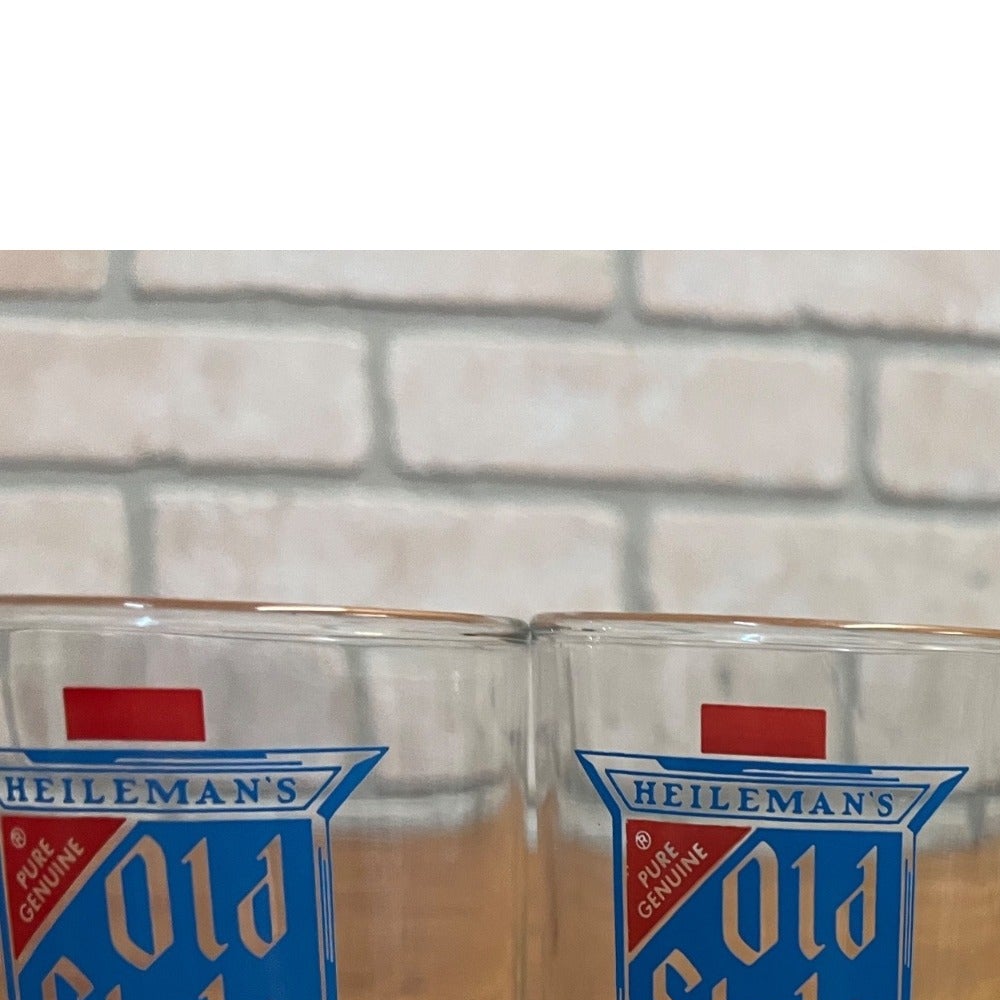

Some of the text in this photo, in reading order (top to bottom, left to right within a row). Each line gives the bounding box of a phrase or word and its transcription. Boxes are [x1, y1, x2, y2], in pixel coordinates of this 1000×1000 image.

[5, 776, 297, 805] HEILEMAN'S
[633, 780, 894, 817] HEILEMAN'S
[15, 837, 54, 889] PURE
[19, 837, 85, 923] GENUINE
[637, 841, 680, 889] PURE
[637, 842, 708, 919] GENUINE
[104, 834, 288, 970] Old
[722, 841, 878, 966] Old
